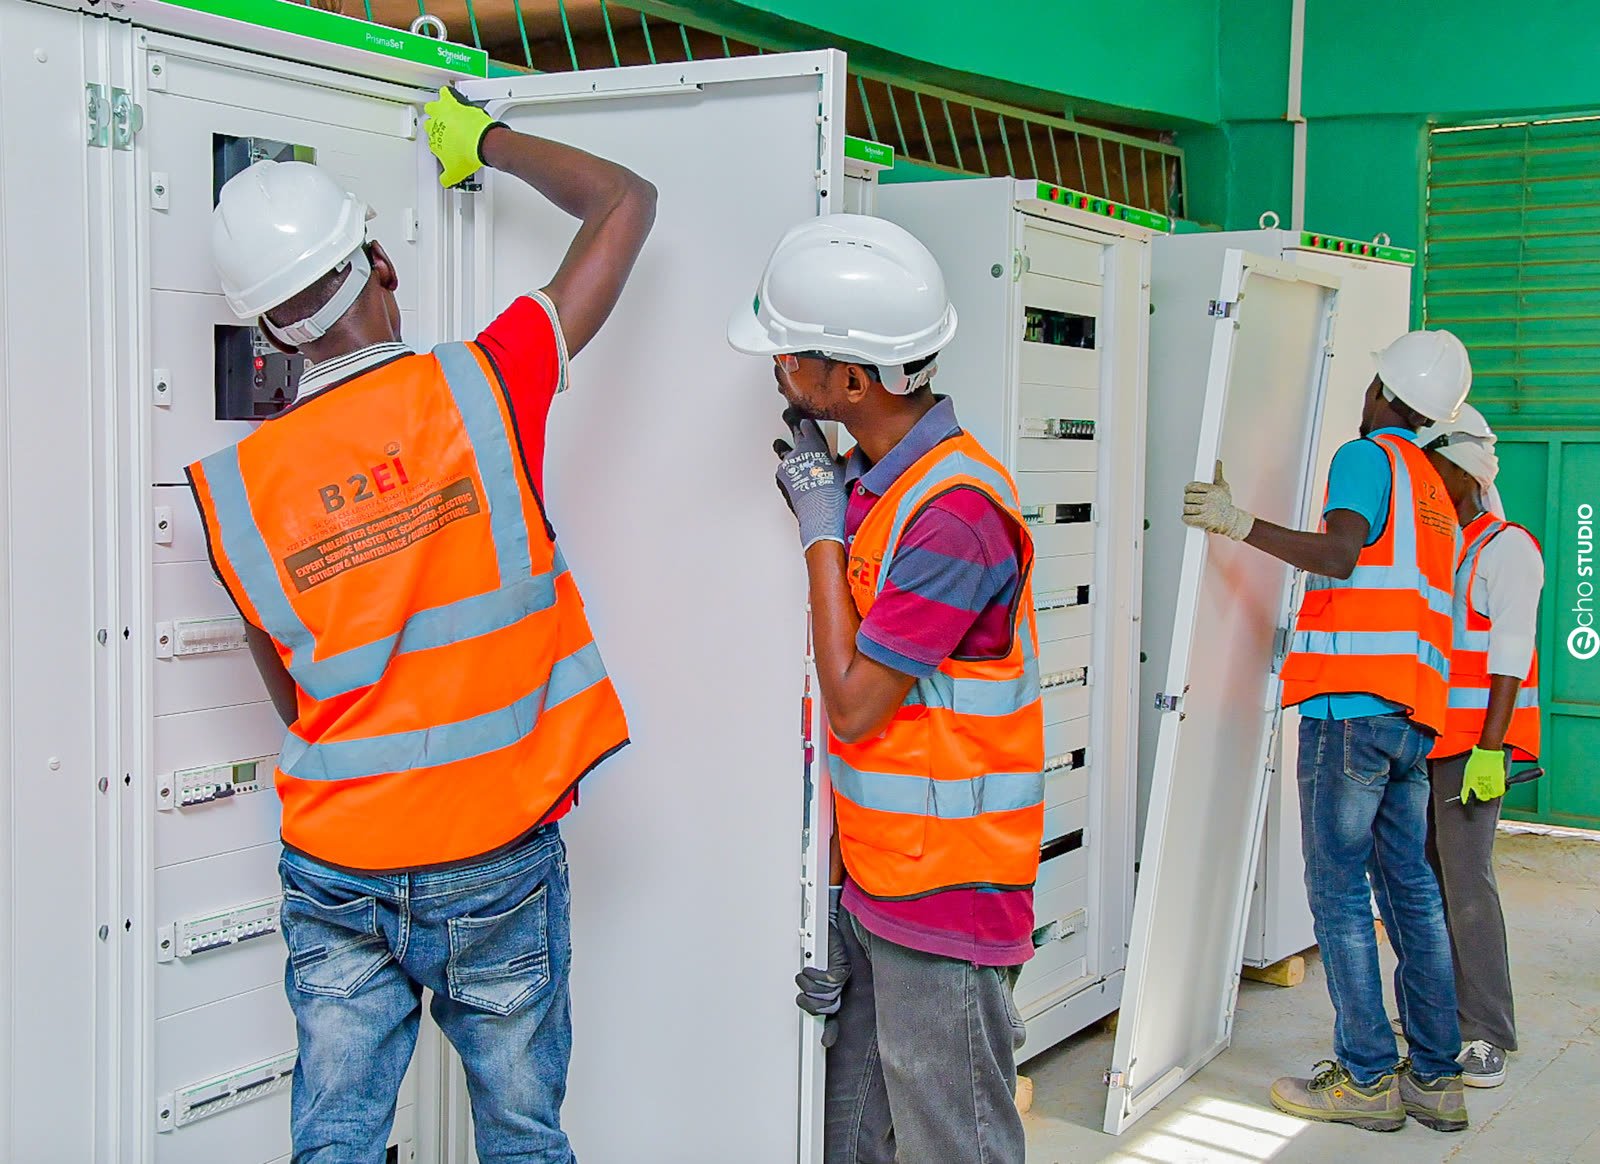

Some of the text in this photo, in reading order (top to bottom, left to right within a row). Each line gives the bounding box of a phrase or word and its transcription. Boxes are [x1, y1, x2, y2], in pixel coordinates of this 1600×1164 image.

[366, 33, 404, 50] PrismaSeT
[437, 47, 471, 62] Schneider
[295, 492, 473, 577] EXPERT SERVICE MASTER DE SCHNEIDER-ELECTRIC
[317, 493, 443, 555] TABLEAUTIER SCHNEIDER-ELECTRIC
[343, 557, 352, 567] &
[351, 536, 407, 564] MAINTENANCE
[409, 520, 439, 540] BUREAU
